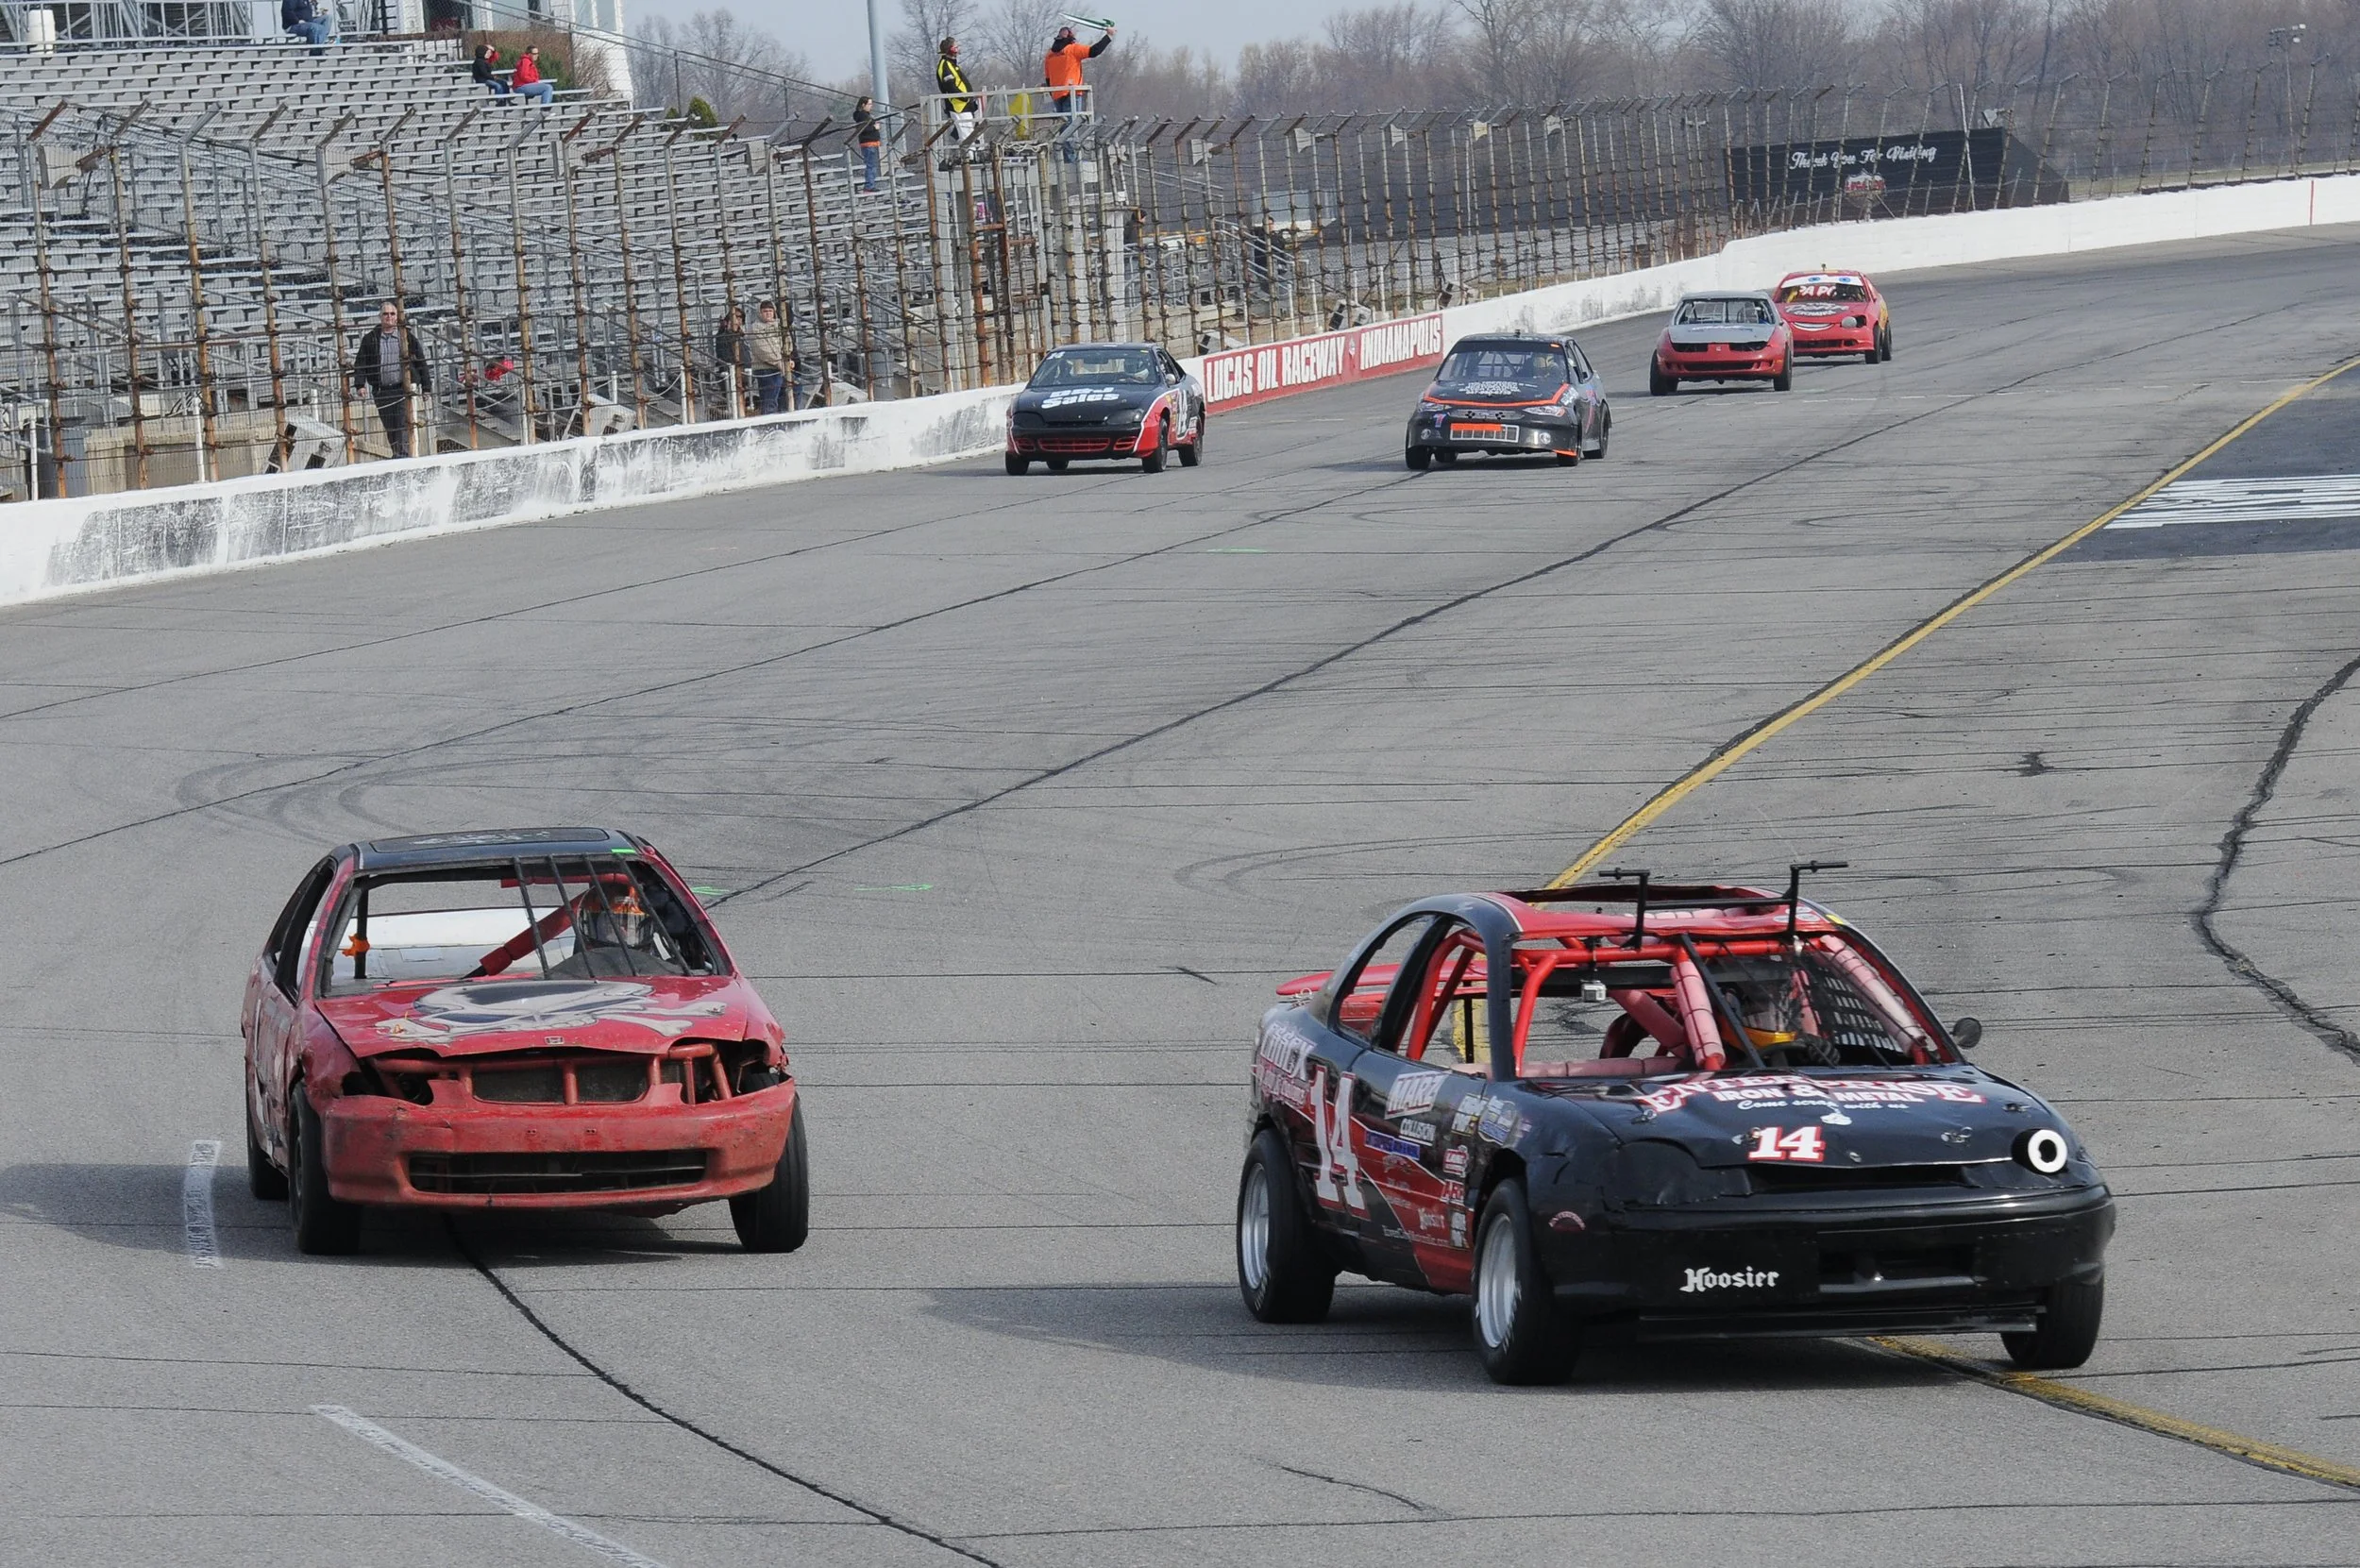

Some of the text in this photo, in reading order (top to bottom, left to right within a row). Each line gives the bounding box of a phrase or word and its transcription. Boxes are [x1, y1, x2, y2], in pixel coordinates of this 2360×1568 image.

[1829, 151, 1857, 169] You
[1205, 316, 1442, 403] LUCAS OIL RACEWAY INDIANAPOLIS
[1040, 392, 1121, 410] Sales
[1387, 1071, 1449, 1115] MARZ
[1634, 1074, 1987, 1114] ENTERPRISE
[1711, 1083, 1927, 1104] IRON & METAL
[1737, 1099, 1789, 1110] Come
[1843, 1101, 1884, 1109] with
[1308, 1064, 1369, 1220] 14
[1400, 1118, 1437, 1142] COLLISION
[1747, 1125, 1827, 1163] 14
[1679, 1265, 1779, 1292] Hoosier
